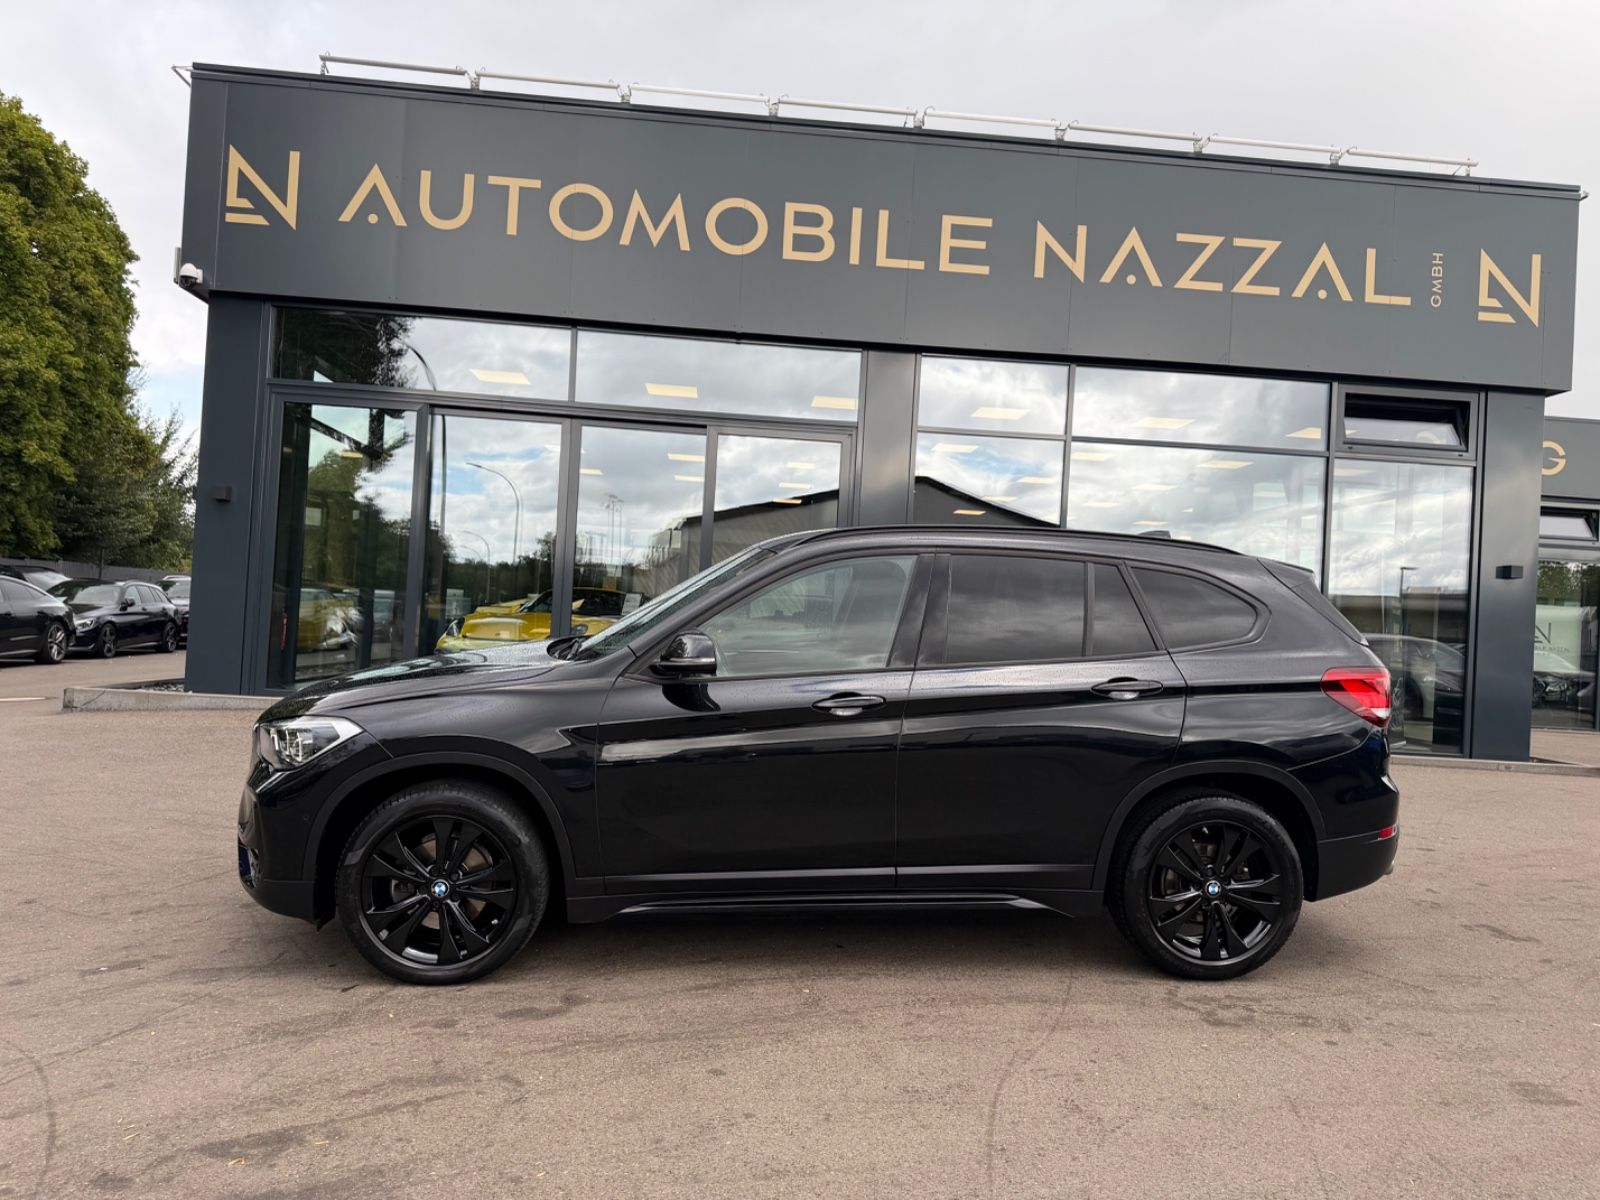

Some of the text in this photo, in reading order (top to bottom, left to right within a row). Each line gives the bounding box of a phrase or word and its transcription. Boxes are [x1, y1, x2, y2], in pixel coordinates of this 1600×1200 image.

[338, 165, 1412, 306] AUTOMOBILE NAZZAL
[1430, 251, 1444, 308] GMBH
